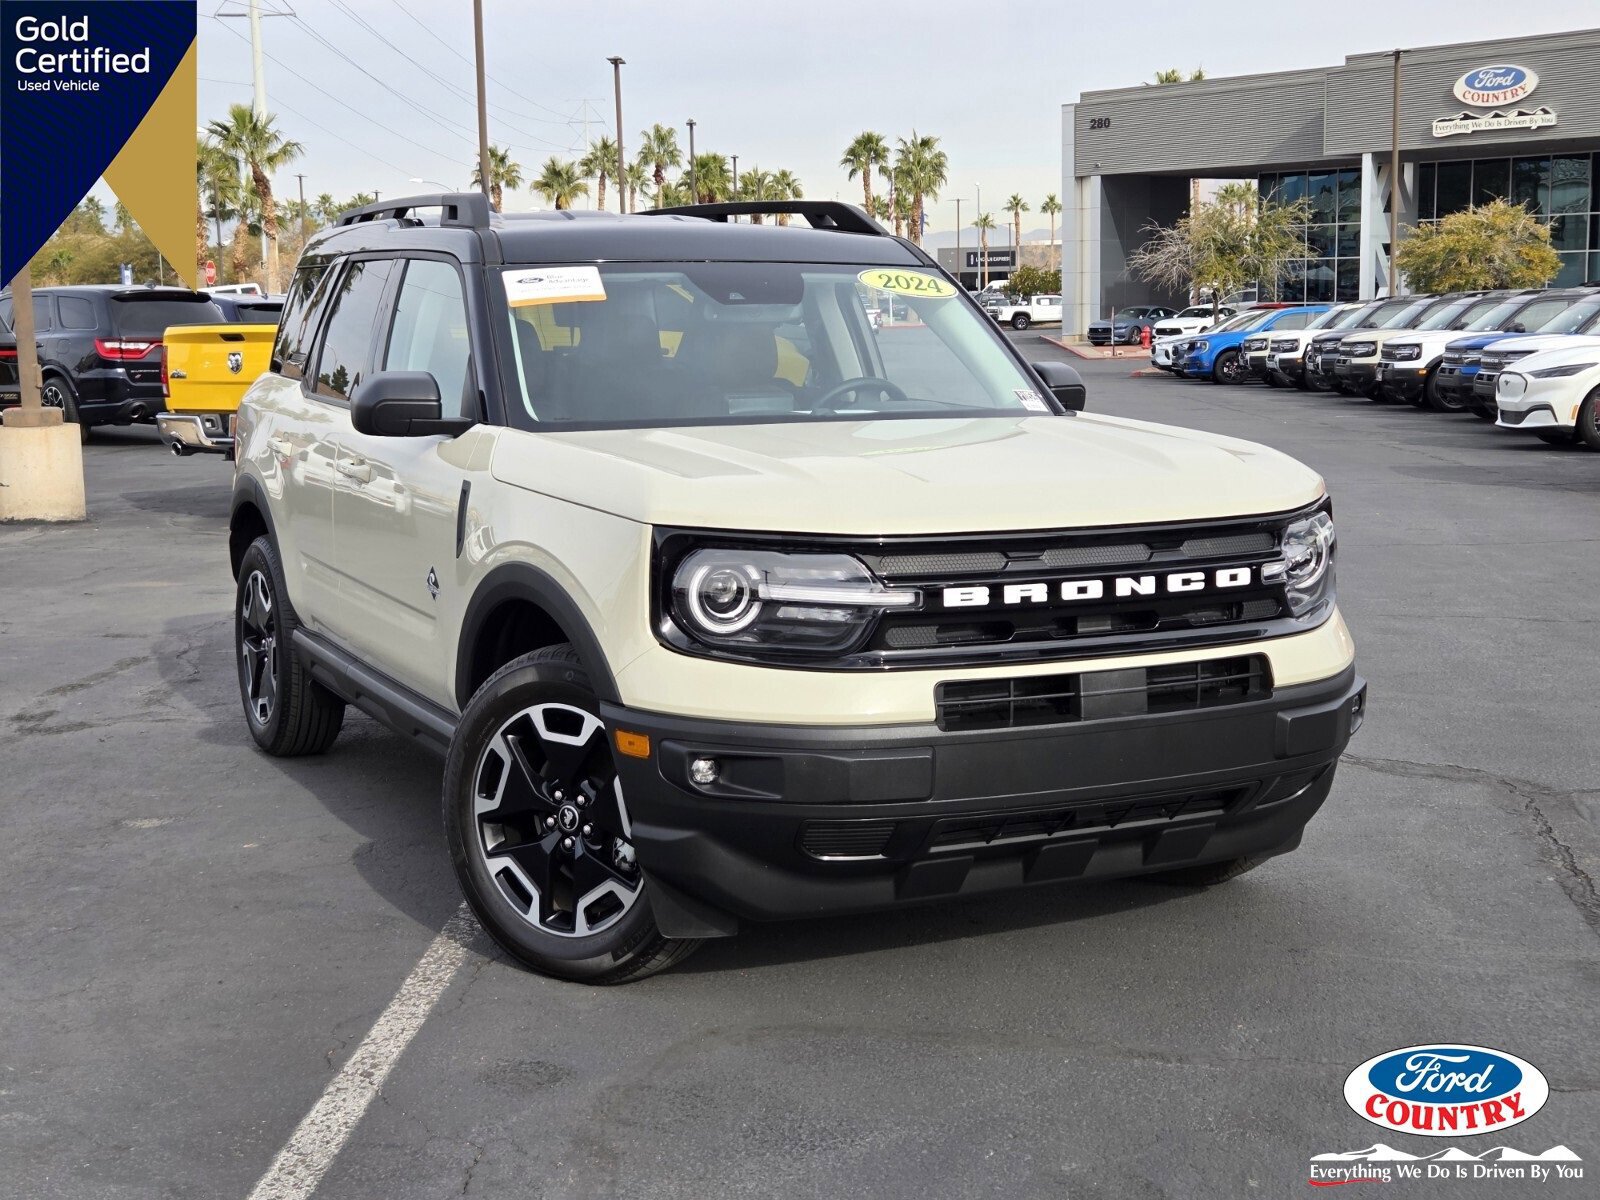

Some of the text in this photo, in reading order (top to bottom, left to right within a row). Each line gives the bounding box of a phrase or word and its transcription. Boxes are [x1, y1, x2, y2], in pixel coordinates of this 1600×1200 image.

[1474, 68, 1516, 88] Ford
[1462, 83, 1528, 103] COUNTRY
[1089, 117, 1111, 130] 280
[1435, 123, 1470, 132] Everything
[1504, 118, 1527, 126] Driven
[1529, 117, 1538, 125] By
[878, 274, 943, 293] 2024
[943, 567, 1251, 608] BRONCO
